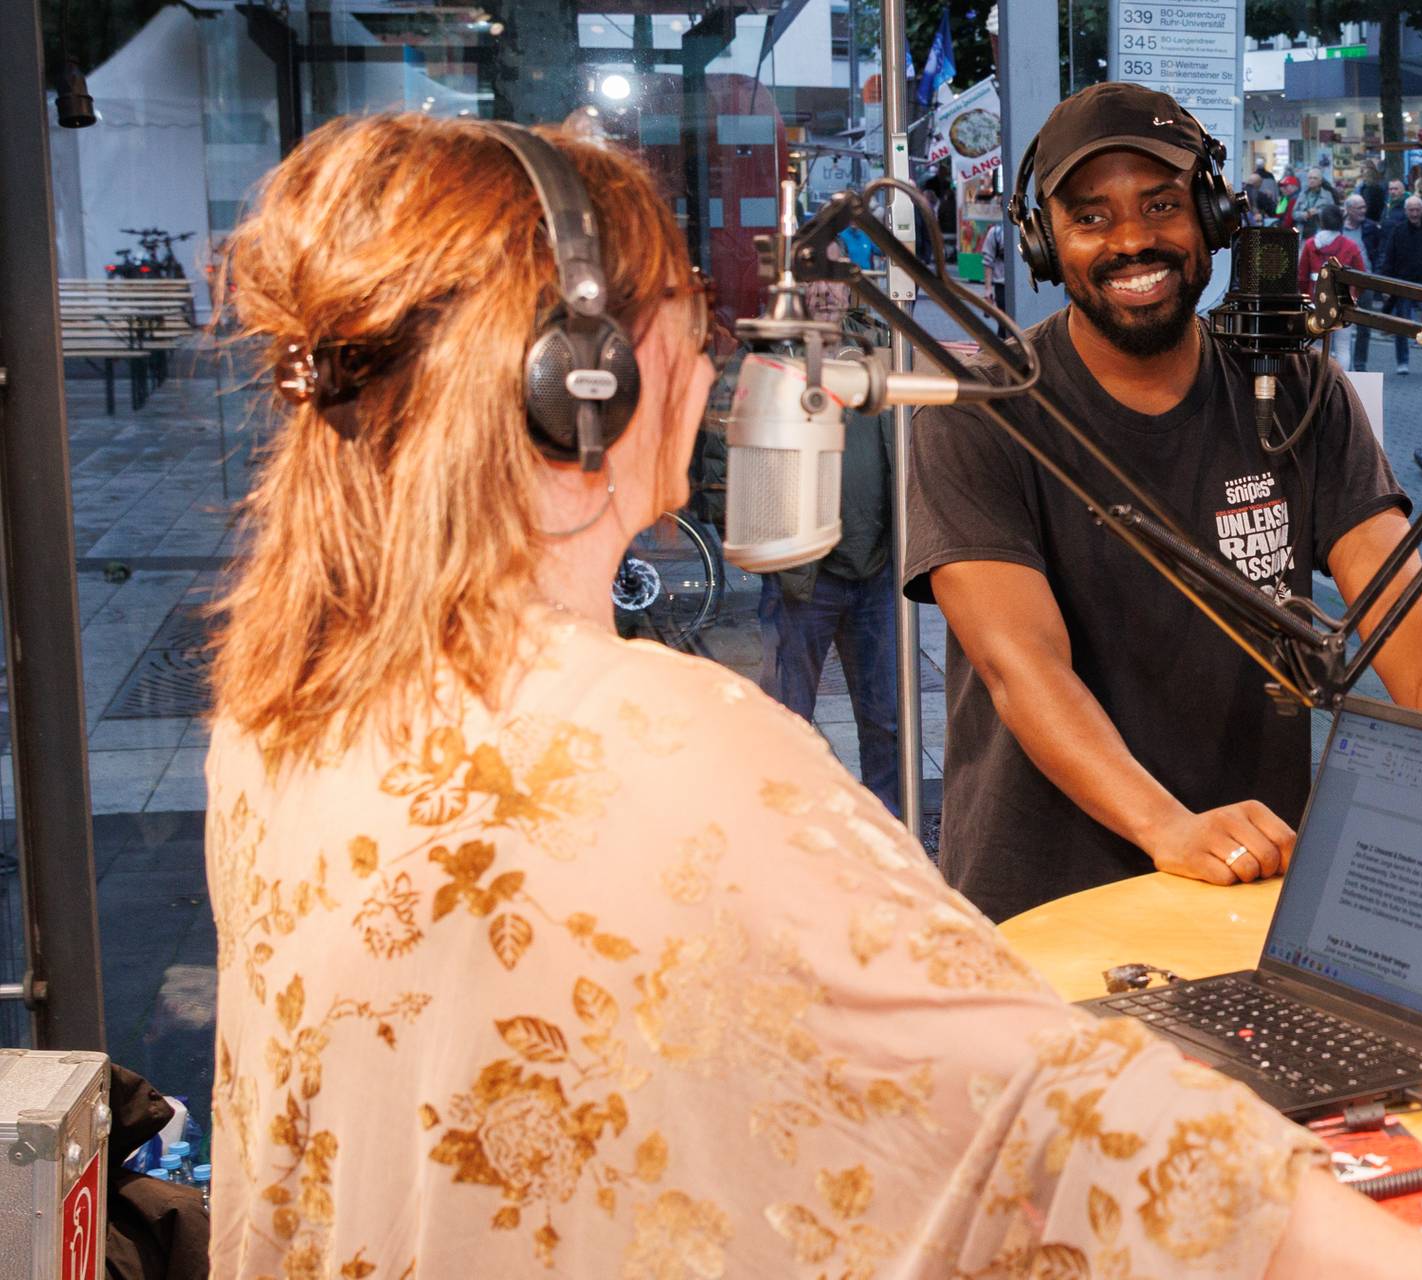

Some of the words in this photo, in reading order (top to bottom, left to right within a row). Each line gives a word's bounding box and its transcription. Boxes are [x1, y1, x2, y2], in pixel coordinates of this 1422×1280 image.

[1123, 9, 1153, 24] 339
[1160, 9, 1226, 20] BO-Querenburg
[1160, 18, 1225, 28] Ruhr-Universität
[1123, 35, 1157, 50] 345
[1123, 60, 1153, 75] 353
[1160, 60, 1209, 69] BO-Weitmar
[1160, 69, 1220, 79] Blankensteiner
[1216, 501, 1288, 538] UNLEASH
[1236, 547, 1295, 581] ASSION
